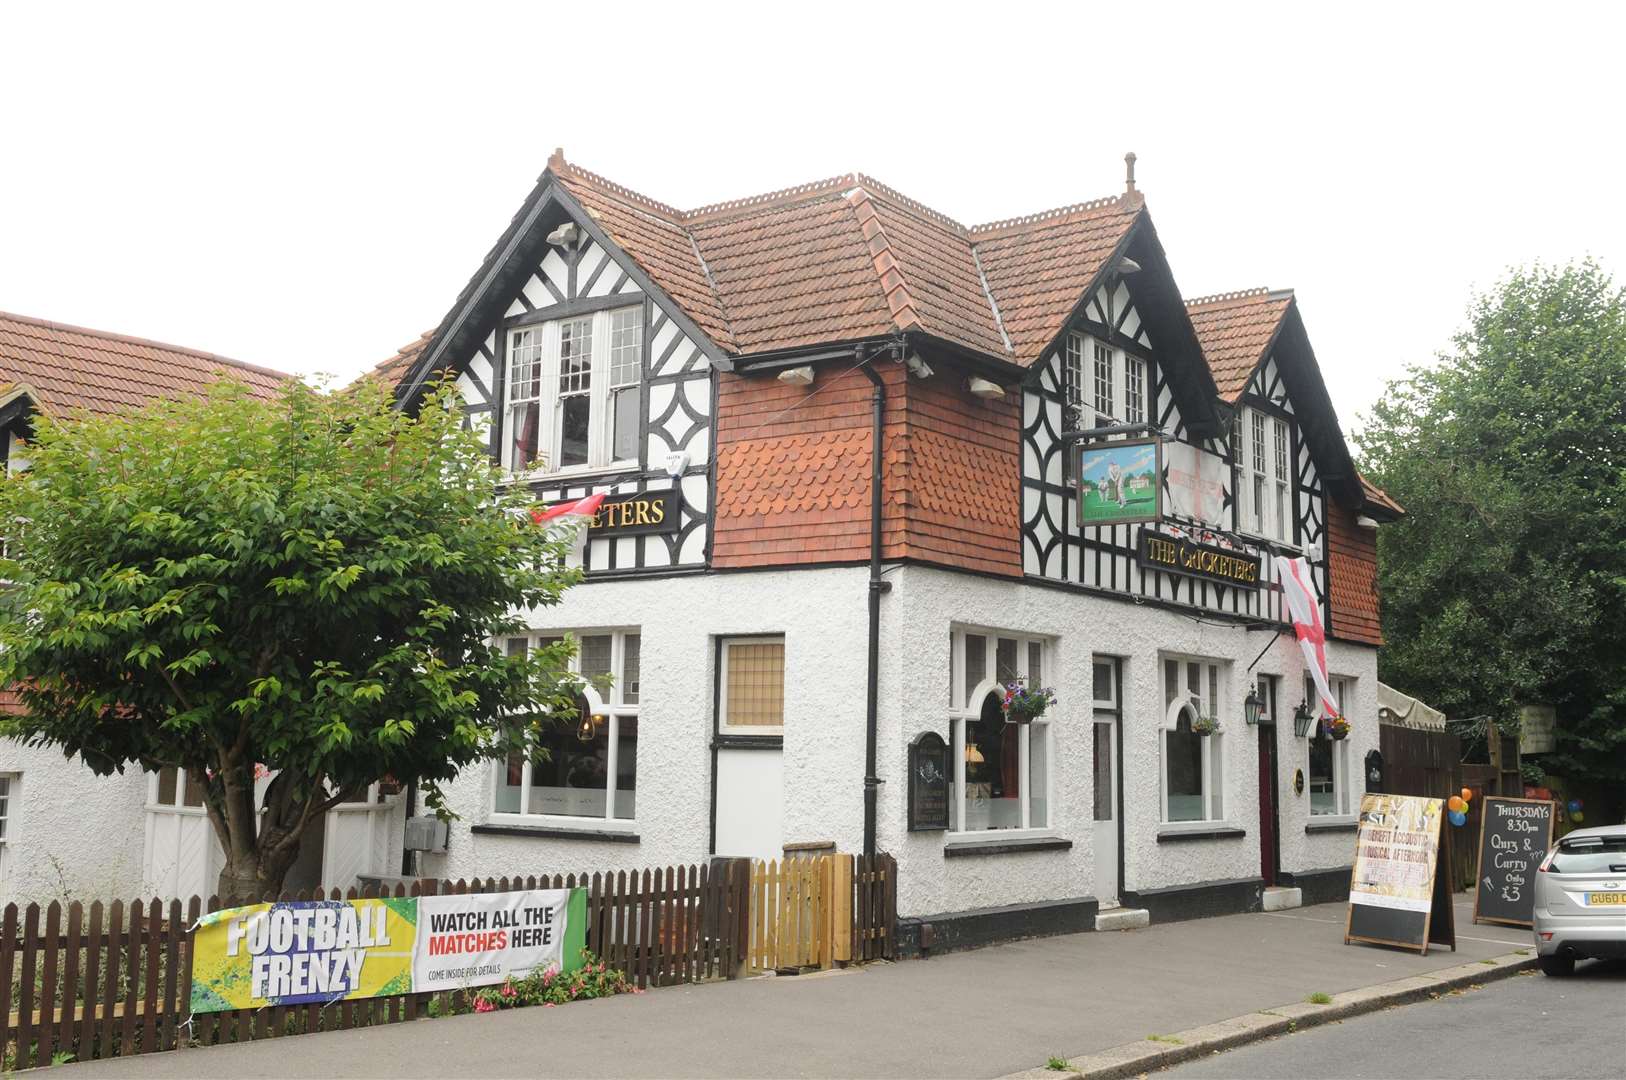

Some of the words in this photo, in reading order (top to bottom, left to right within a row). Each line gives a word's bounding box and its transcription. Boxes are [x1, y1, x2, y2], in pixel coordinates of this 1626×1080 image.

[1147, 537, 1176, 564] THE
[1180, 544, 1256, 582] CRICKETERS
[1491, 834, 1518, 854] Quiz
[1523, 838, 1532, 851] &
[1494, 853, 1527, 873] Curry
[1505, 873, 1525, 886] Only
[1501, 886, 1521, 902] £3
[1591, 893, 1618, 904] GU60
[431, 911, 487, 933] WATCH
[492, 909, 519, 929] ALL
[524, 907, 553, 926] THE
[226, 905, 391, 957] FOOTBALL
[429, 930, 507, 956] MATCHES
[511, 927, 552, 948] HERE
[252, 948, 367, 999] FRENZY
[428, 969, 445, 981] COME
[445, 968, 465, 980] INSIDE
[466, 967, 478, 978] FOR
[478, 964, 501, 977] DETAILS
